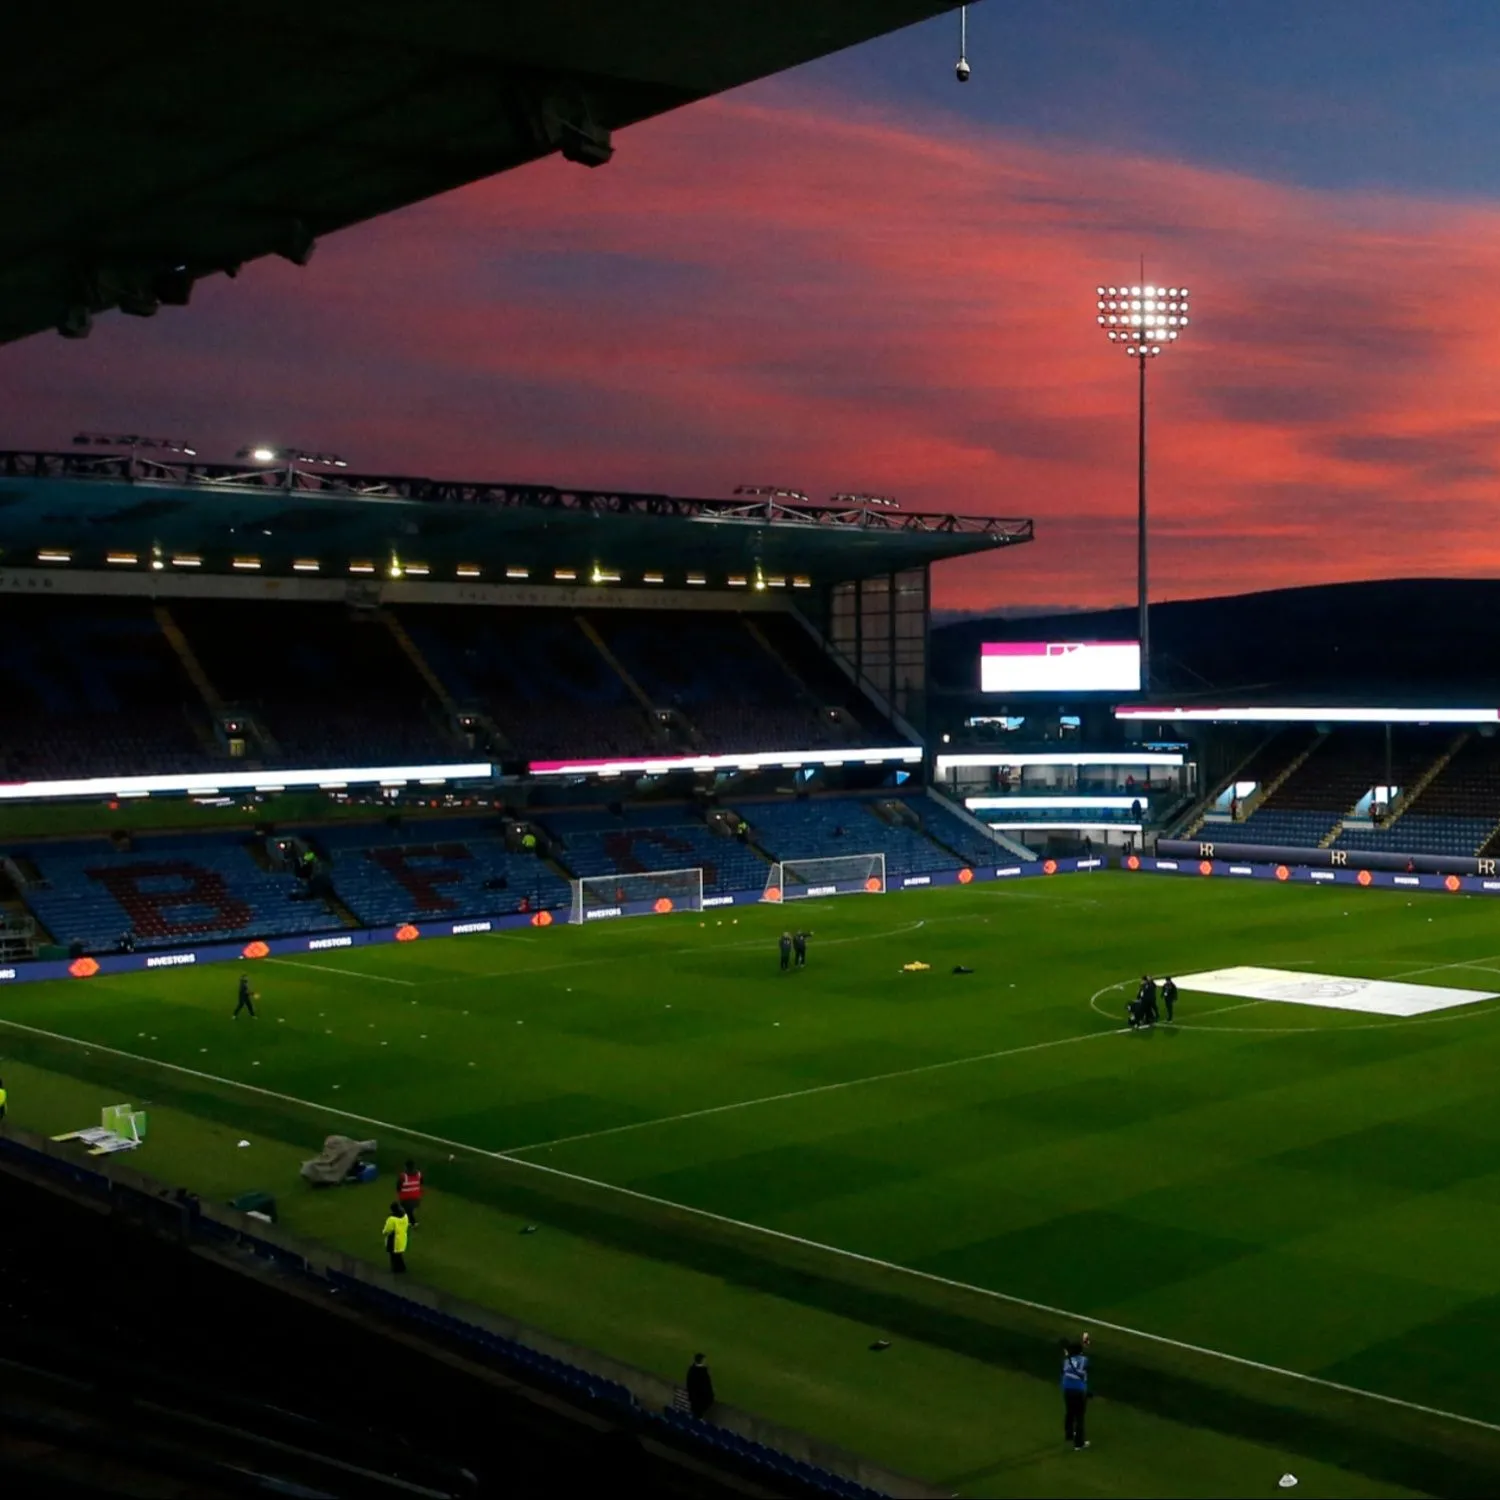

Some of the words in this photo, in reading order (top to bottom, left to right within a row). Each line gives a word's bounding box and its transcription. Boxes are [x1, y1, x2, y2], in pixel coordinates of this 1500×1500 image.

[1199, 842, 1215, 857] HR
[1331, 850, 1347, 865] HR
[1478, 859, 1496, 874] HR
[86, 860, 253, 938] B
[369, 846, 470, 910] F
[147, 953, 196, 967] INVESTORS
